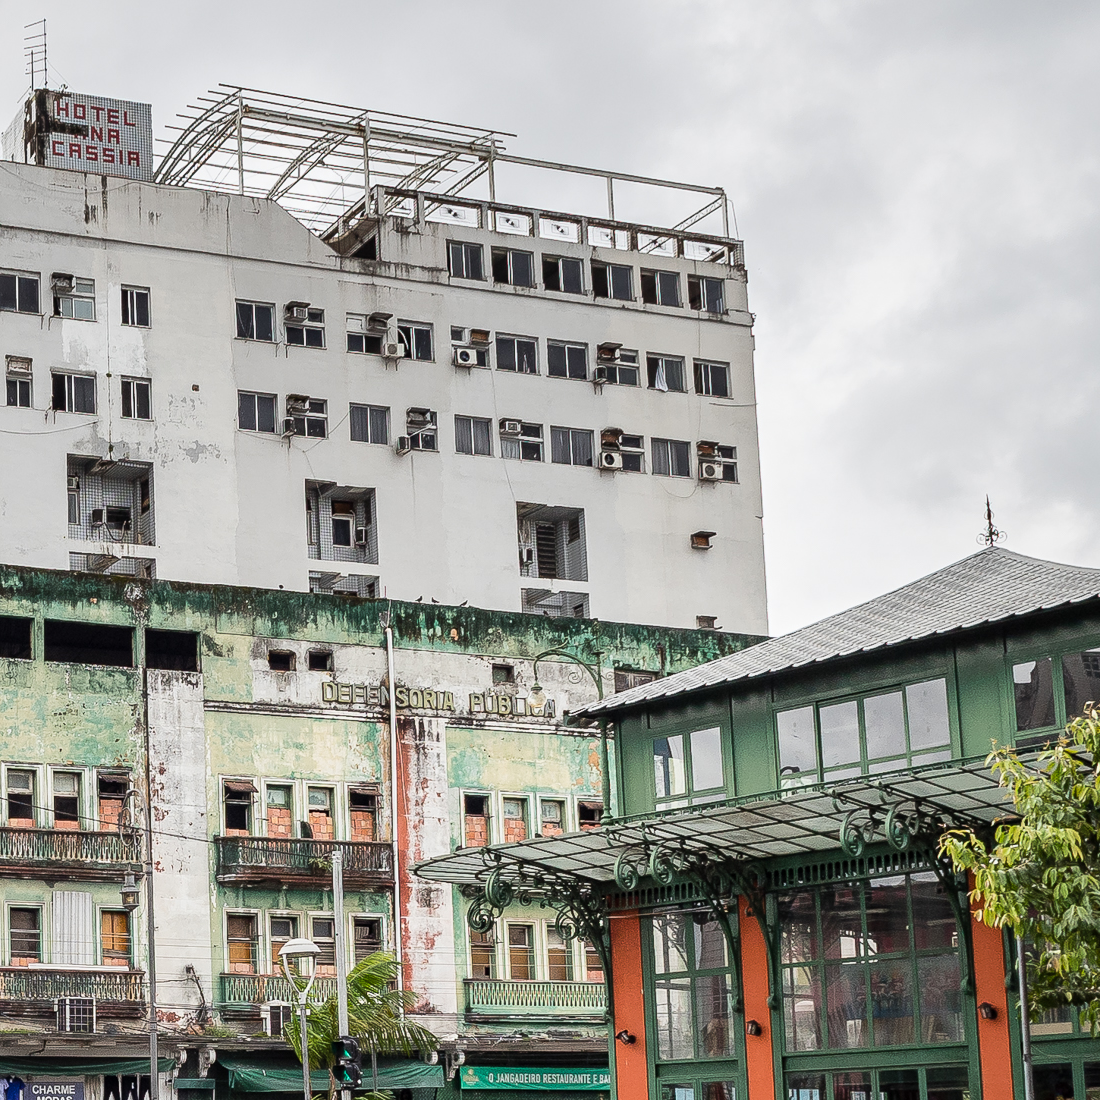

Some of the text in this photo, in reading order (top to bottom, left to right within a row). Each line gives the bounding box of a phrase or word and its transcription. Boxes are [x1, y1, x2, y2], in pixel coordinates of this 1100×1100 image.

[56, 100, 136, 127] HOTEL
[52, 140, 140, 167] CASSIA
[322, 681, 455, 711] DEFENSORIA
[32, 1084, 75, 1095] CHARME
[488, 1073, 494, 1083] O
[496, 1073, 541, 1084] JANGADEIRO
[542, 1073, 591, 1084] RESTAURANTE
[593, 1074, 598, 1084] E
